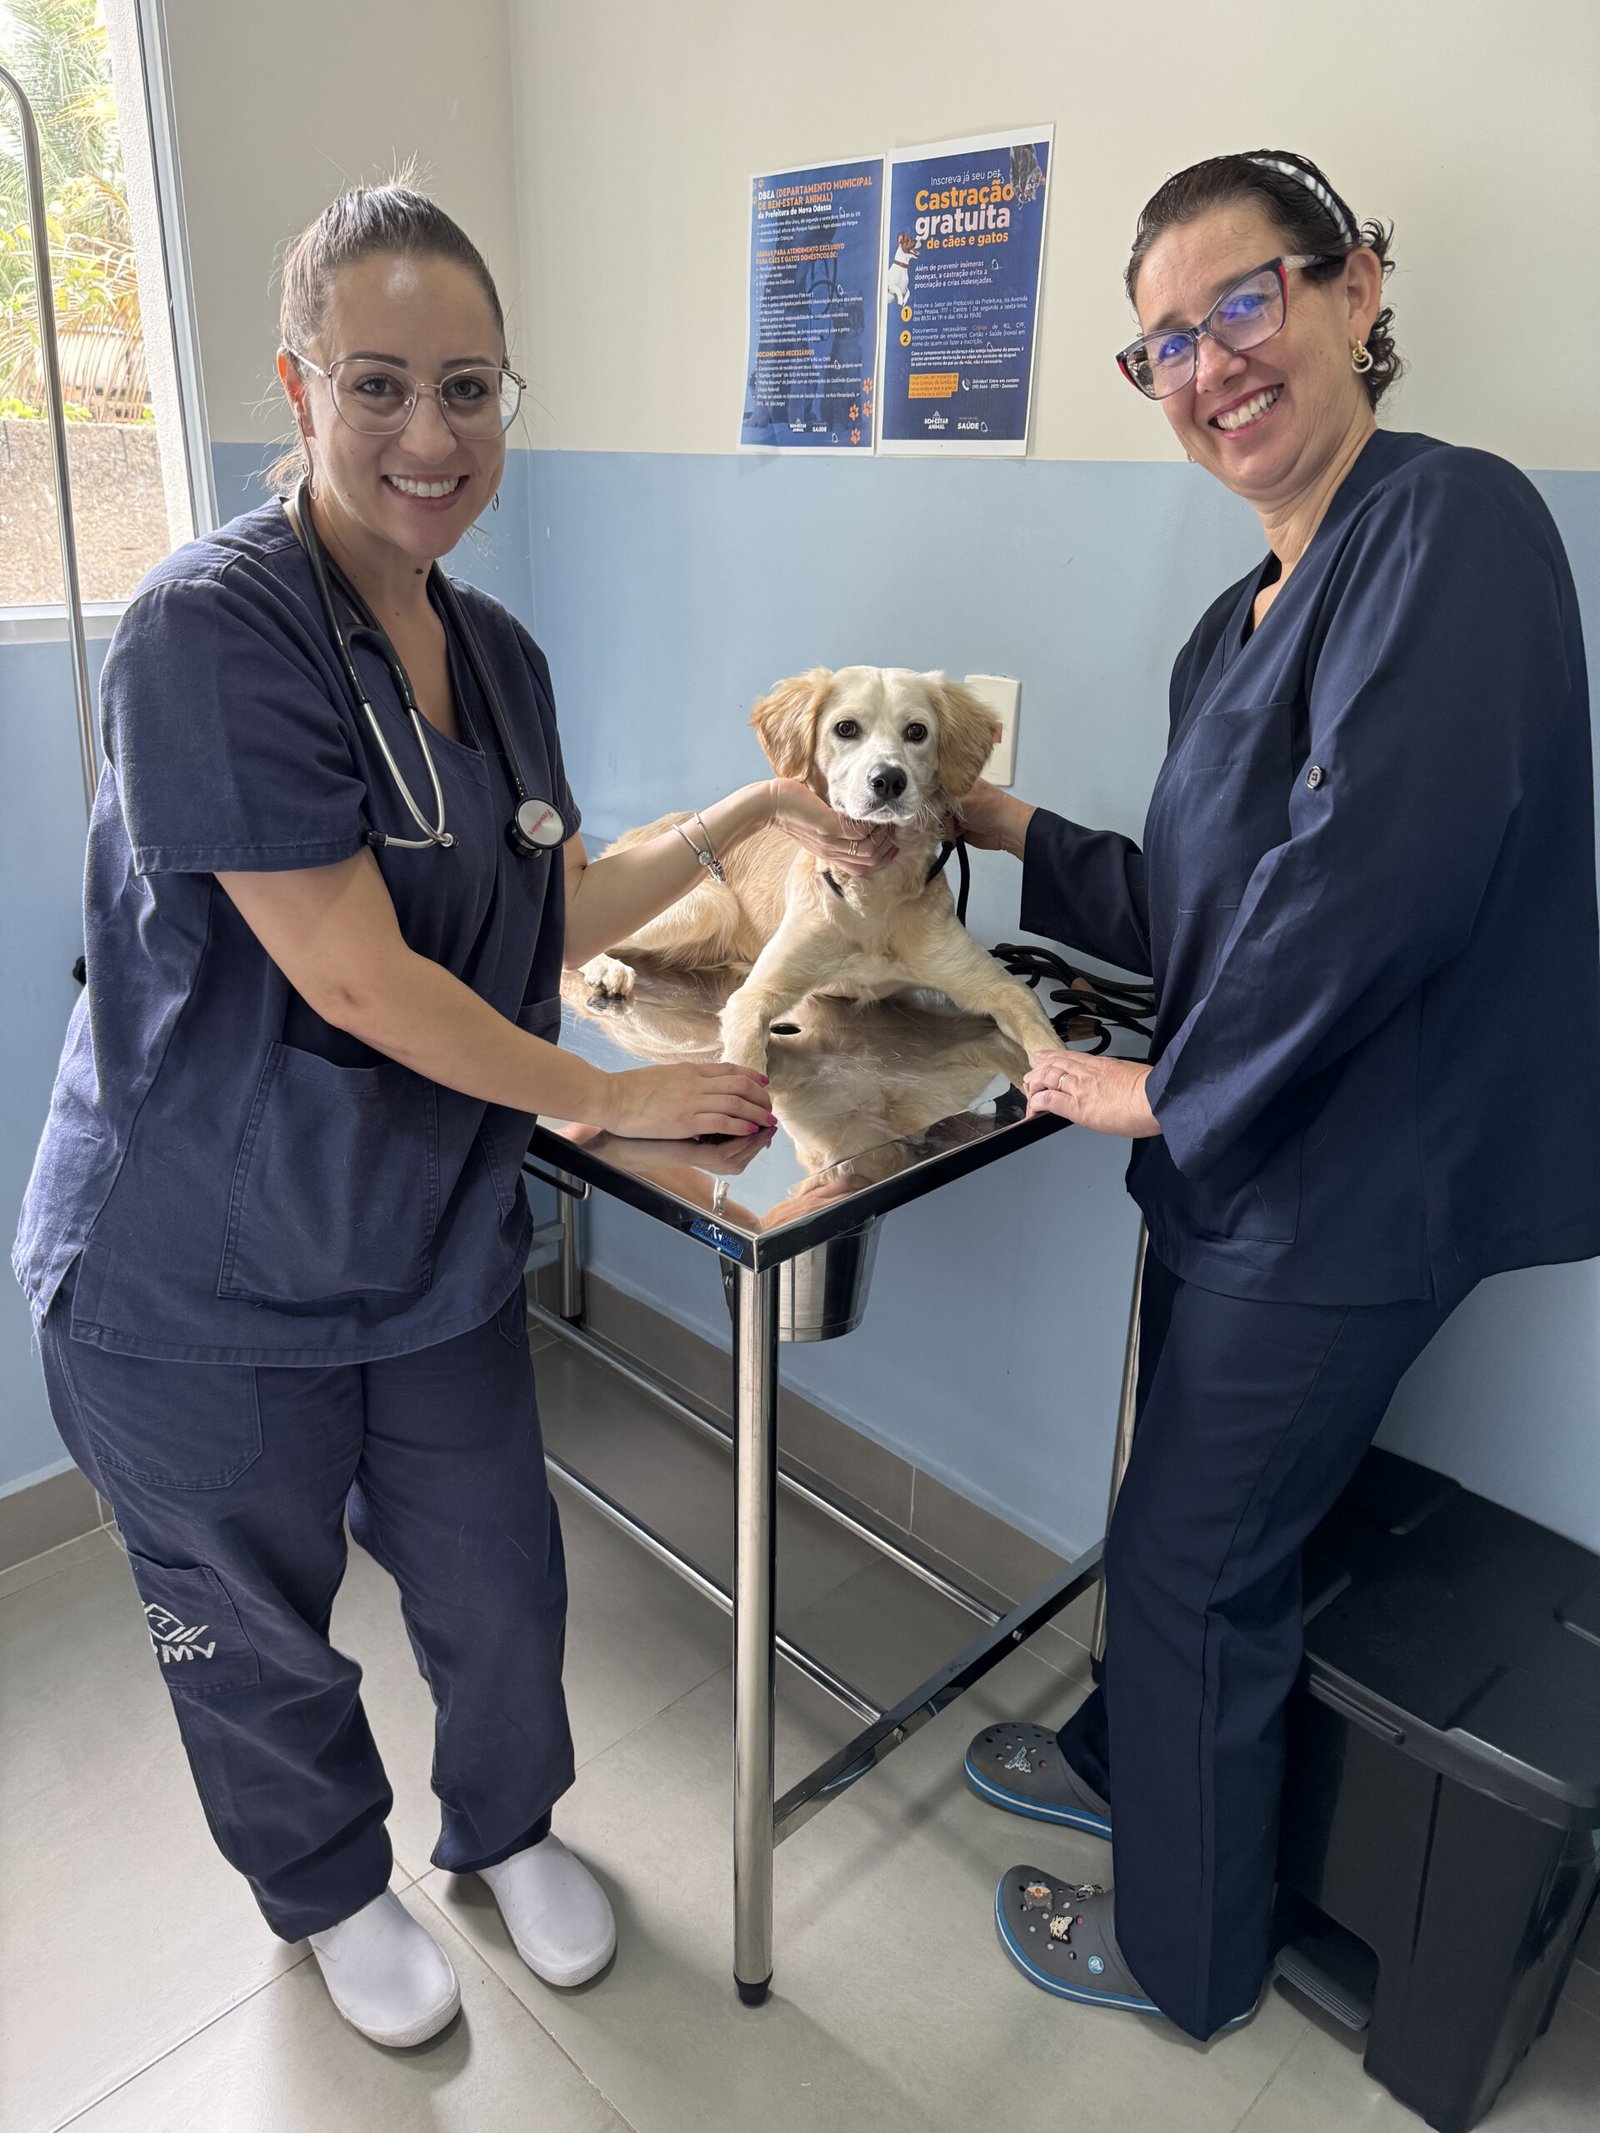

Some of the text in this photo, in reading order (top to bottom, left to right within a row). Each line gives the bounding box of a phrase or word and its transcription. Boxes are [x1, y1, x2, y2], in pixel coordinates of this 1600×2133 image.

[930, 172, 962, 186] Inscreva
[962, 171, 970, 184] já
[972, 172, 986, 182] seu
[758, 176, 872, 200] DBEA (DEPARTAMENTO MUNICIPAL
[768, 196, 803, 210] BEM-ESTAR
[805, 192, 833, 204] ANIMAL)
[758, 212, 764, 220] da
[765, 209, 790, 218] Prefeitura
[790, 207, 798, 216] de
[798, 206, 812, 214] Nova
[813, 204, 832, 212] Odessa
[915, 203, 1010, 241] gratuita
[926, 232, 1009, 250] de cães e gatos
[785, 254, 800, 262] GATOS
[914, 264, 929, 272] Além
[937, 262, 960, 272] prevenir
[960, 260, 984, 268] inúmeras
[914, 272, 938, 281] doenças,
[943, 268, 969, 278] castração
[914, 280, 942, 290] procriação
[904, 309, 908, 318] 1
[980, 304, 999, 312] segunda
[903, 334, 908, 342] 2
[958, 420, 980, 430] SAÚDE
